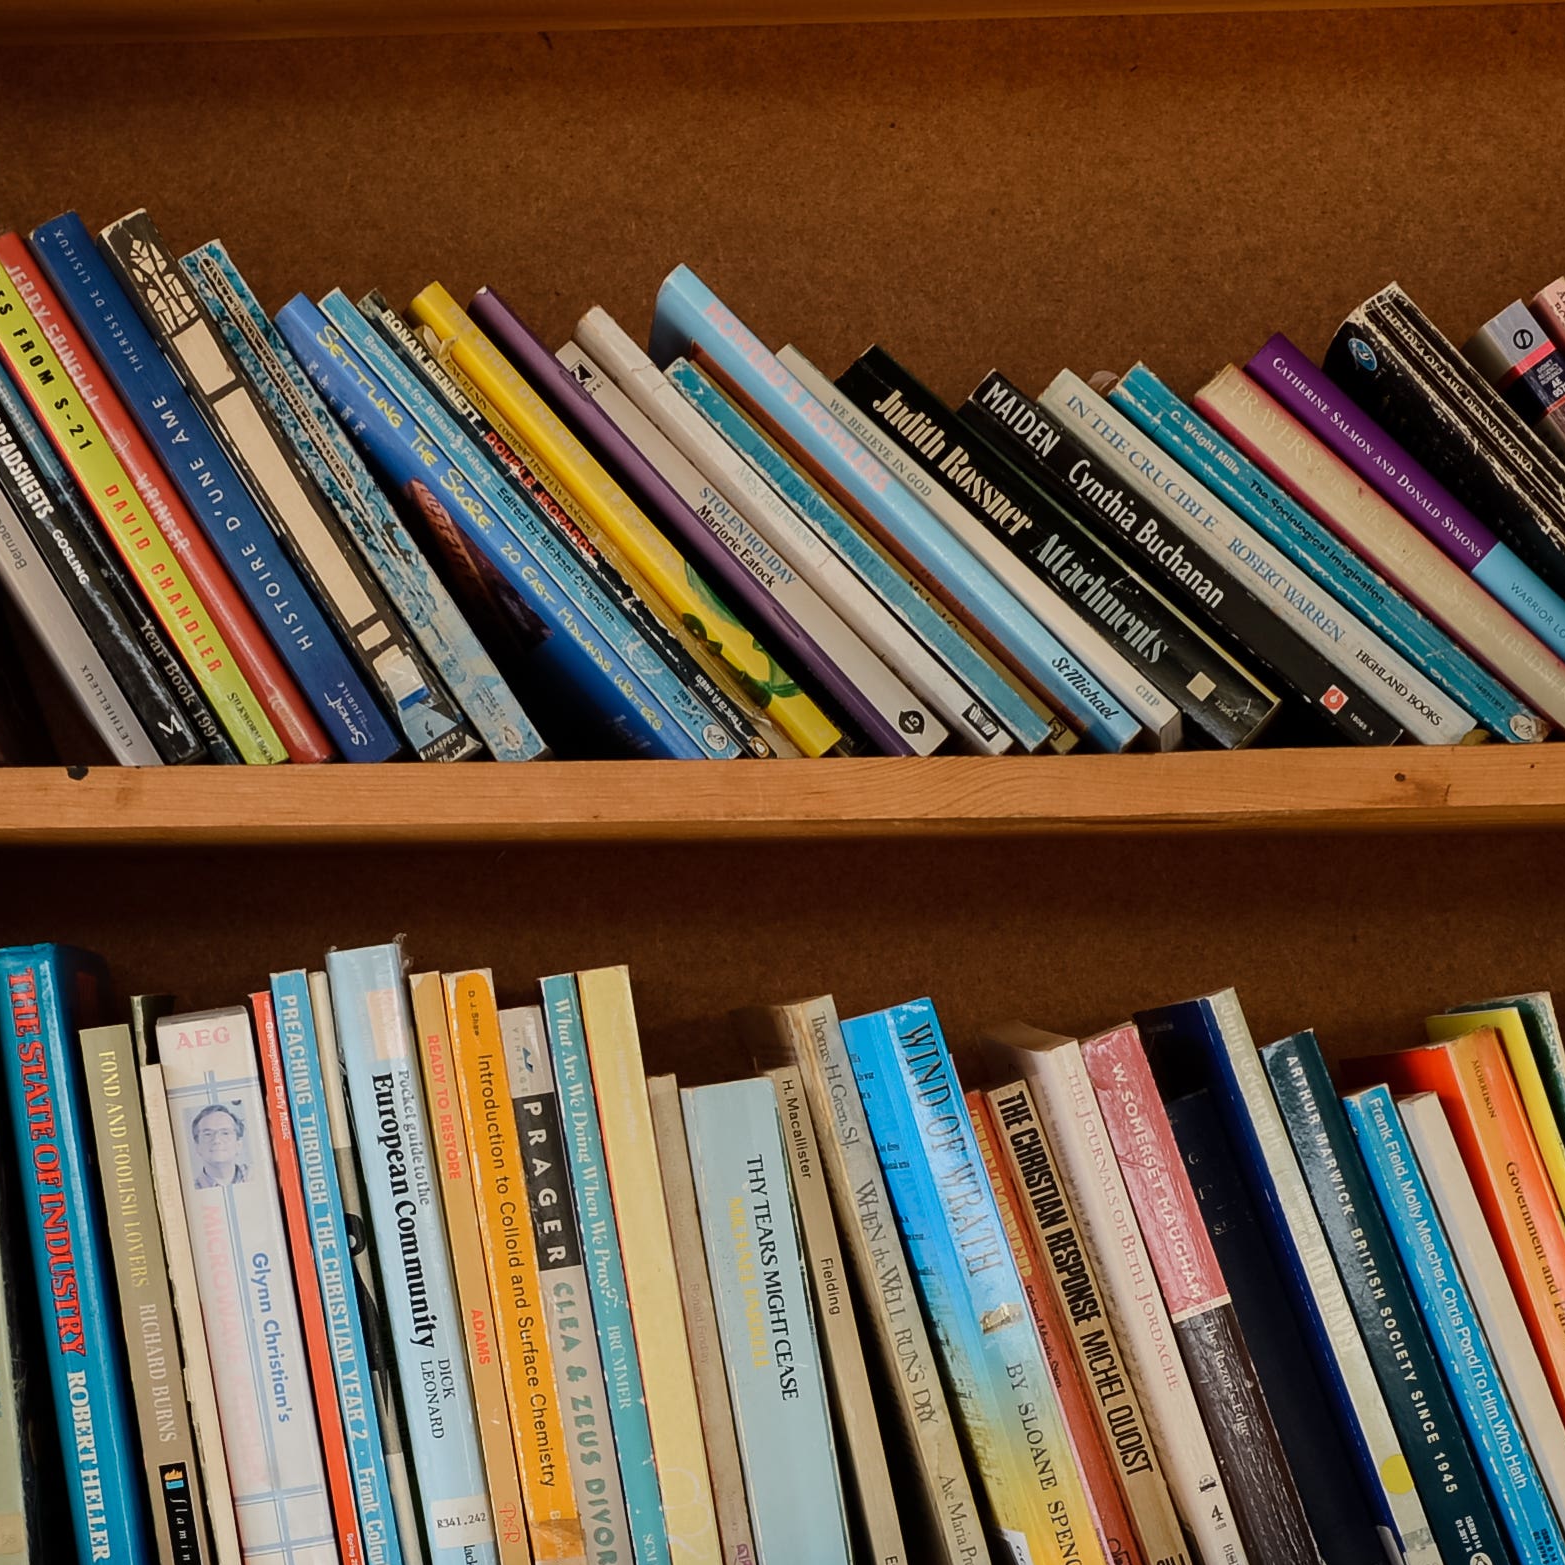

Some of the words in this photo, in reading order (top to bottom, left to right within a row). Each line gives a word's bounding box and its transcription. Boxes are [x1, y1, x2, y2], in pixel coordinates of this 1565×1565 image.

[13, 327, 55, 387] FROM
[54, 394, 95, 452] S-21
[700, 487, 747, 536] STOLEN
[744, 532, 797, 584] HOLIDAY
[872, 390, 942, 464] Judith
[939, 446, 1034, 539] Rossner
[1030, 532, 1169, 666] Attachments
[985, 382, 1061, 459] MAIDEN
[1068, 459, 1139, 532] Cynthia
[1134, 517, 1225, 609] Buchanan
[51, 528, 90, 586] GOSLING
[696, 504, 742, 552] Marjorie
[739, 548, 776, 588] Eatock
[1355, 648, 1409, 699] HIGHLAND
[1402, 690, 1443, 729] BOOKS
[372, 1071, 412, 1198] European
[393, 1198, 435, 1349] Community
[522, 1100, 567, 1264] PRAGER
[746, 1153, 769, 1189] THY
[754, 1194, 778, 1263] TEARS
[252, 1251, 276, 1312] Glynn
[764, 1267, 790, 1339] MIGHT
[263, 1317, 292, 1426] Christian's
[779, 1343, 800, 1400] CEASE
[1351, 1227, 1387, 1301] BRITISH
[1379, 1305, 1416, 1377] SOCIETY
[1410, 1389, 1437, 1445] SINCE
[1434, 1452, 1458, 1493] 1945
